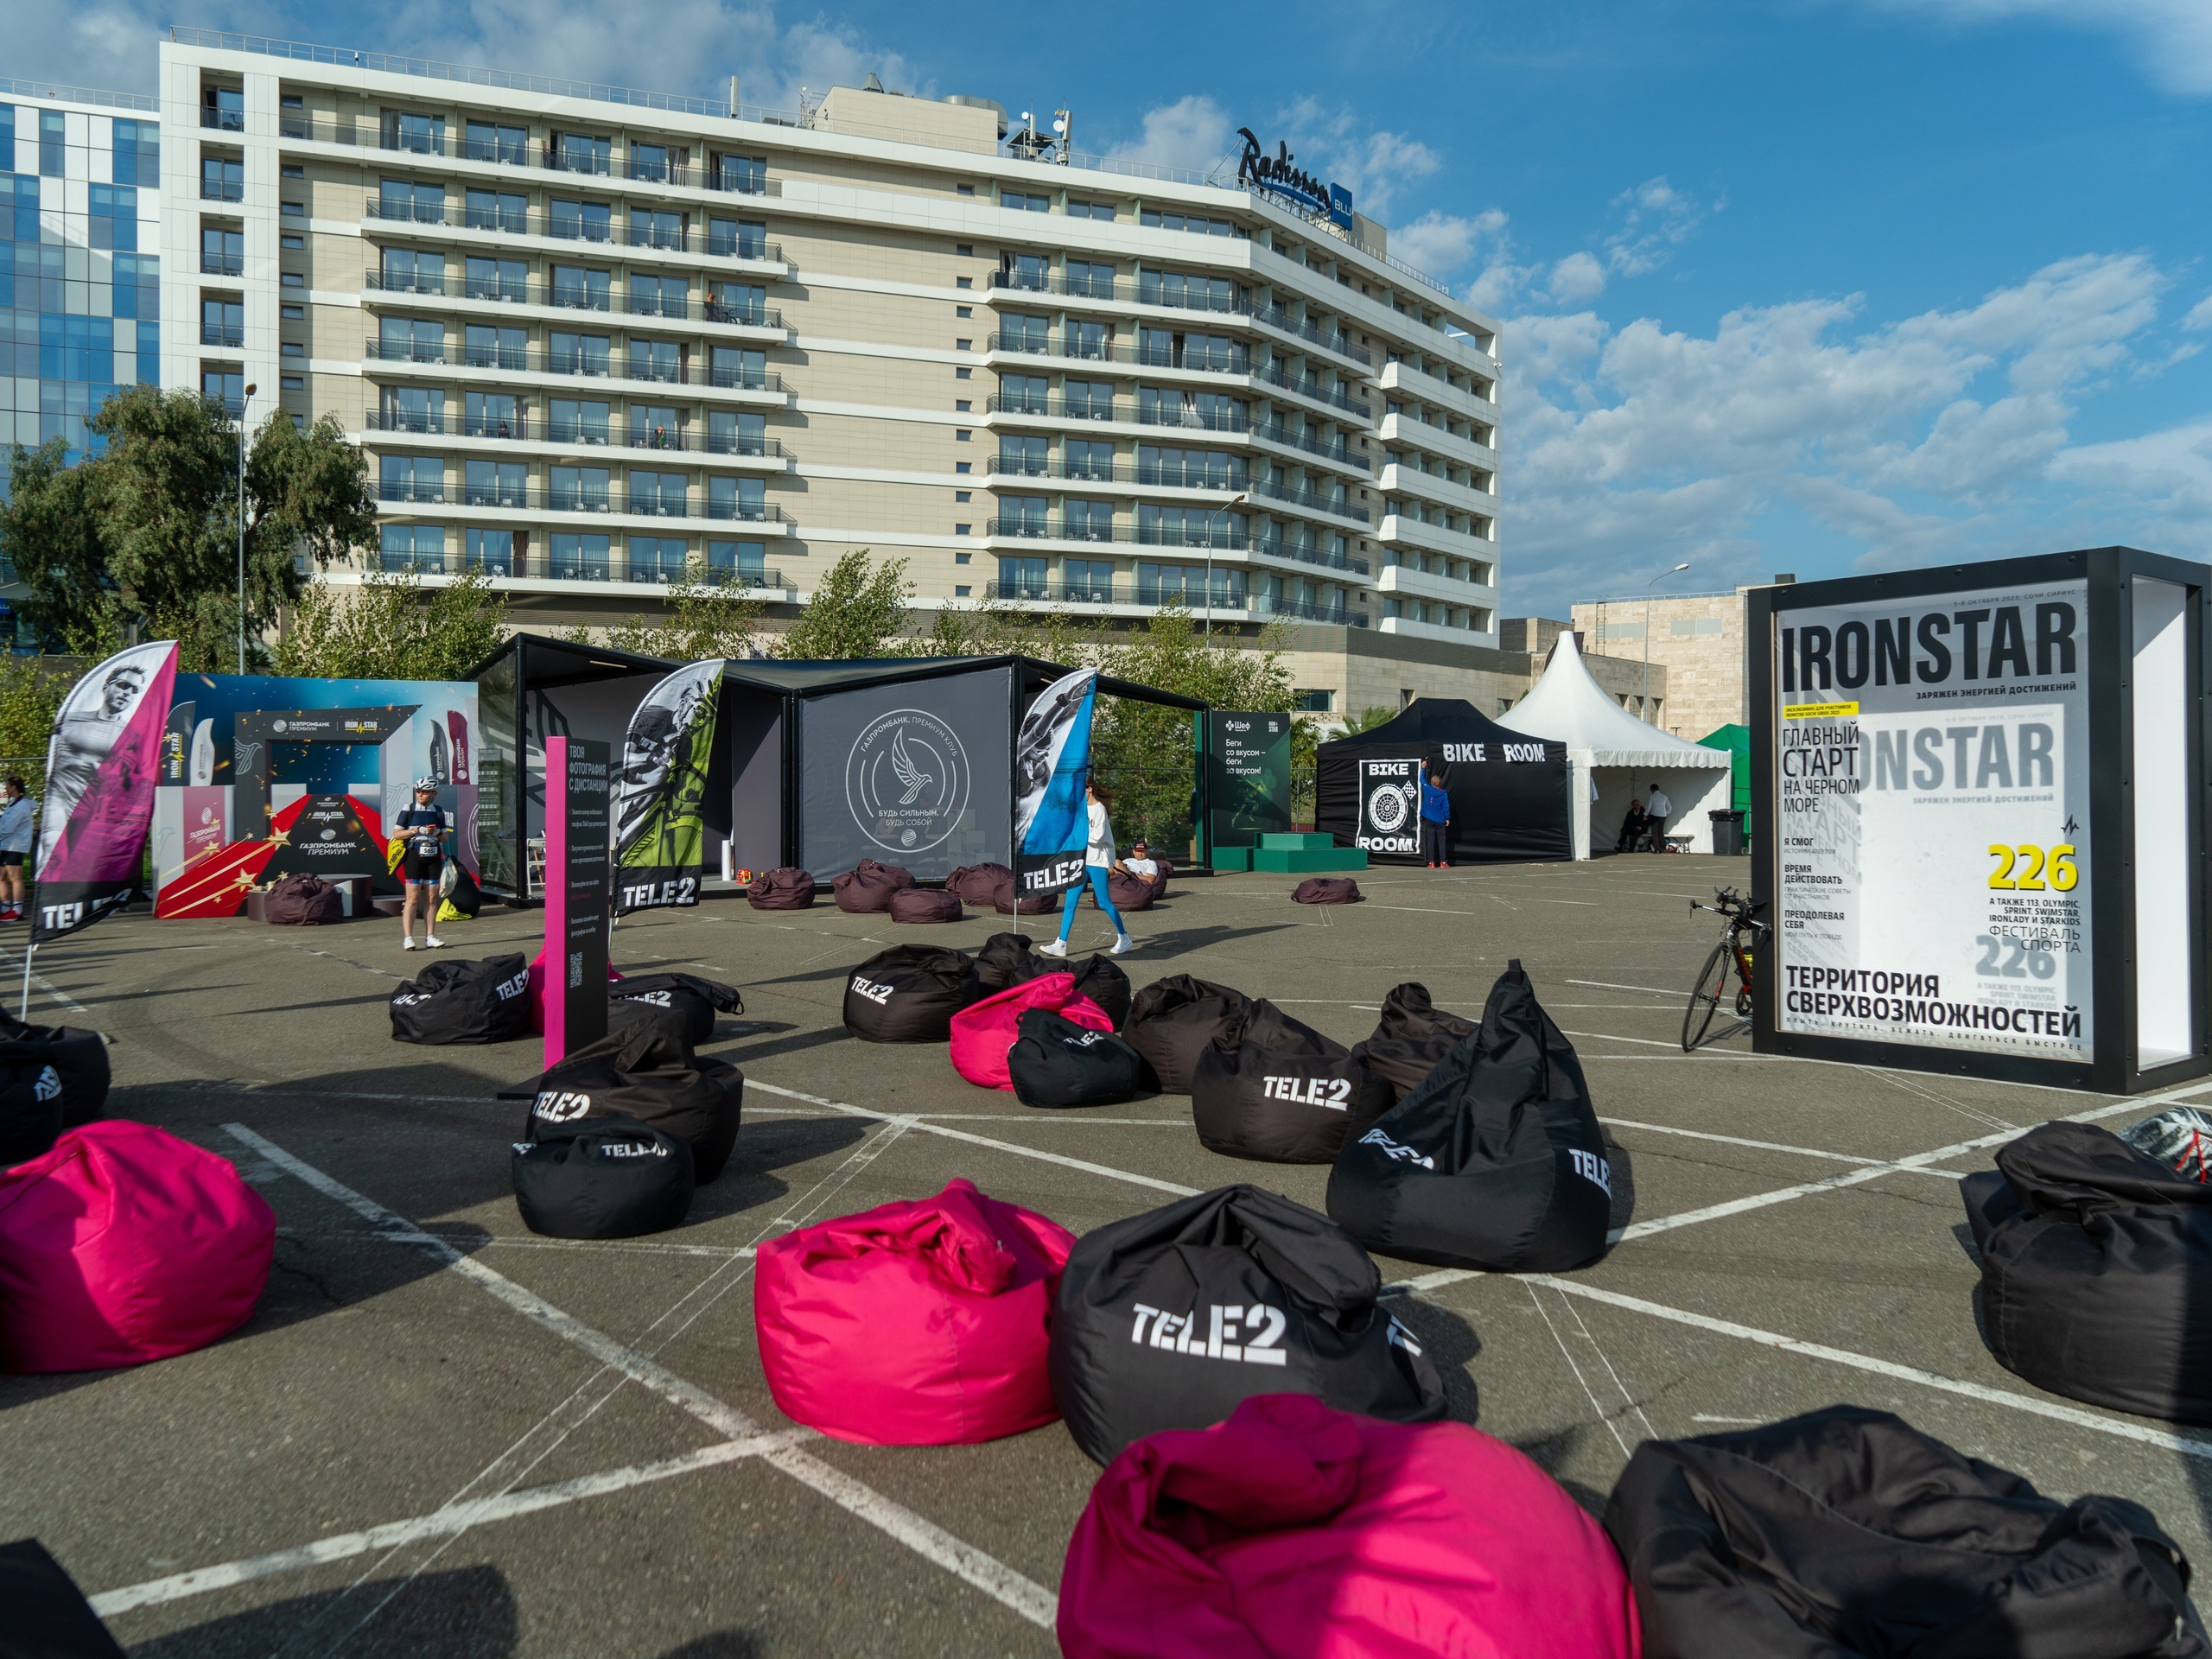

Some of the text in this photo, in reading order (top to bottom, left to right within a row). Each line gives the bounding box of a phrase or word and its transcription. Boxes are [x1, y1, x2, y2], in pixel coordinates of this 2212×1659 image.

[1236, 126, 1352, 217] Radisson BLU
[1967, 596, 1999, 606] ОКТЯБРЯ
[2046, 588, 2076, 597] СИРИУС
[1783, 601, 2077, 693] IRONSTAR
[1916, 680, 2077, 700] ЗАРЯЖЕН ЭНЕРГИЕЙ ДОСТИЖЕНИЙ
[1235, 721, 1251, 731] Шеф
[861, 716, 958, 757] ГАЗПРОМБАНК. ПРЕМИУМ КЛУБ
[1783, 721, 1859, 747] ГЛАВНЫЙ
[569, 745, 585, 759] ТВОЯ
[1236, 749, 1260, 758] вкусом
[1442, 743, 1546, 762] BIKE ROOM
[569, 762, 607, 776] ФОТОГРАФИЯ
[1225, 757, 1242, 766] беги
[1783, 747, 1859, 778] СТАРТ
[1236, 766, 1262, 776] вкусом!
[1369, 763, 1409, 776] BIKE
[569, 778, 608, 793] С ДИСТАНЦИИ
[1783, 779, 1859, 795] НА ЧЕРНОМ
[1783, 798, 1819, 812] МОРЕ
[1951, 794, 1992, 804] ЭНЕРГИЕЙ
[1993, 792, 2054, 804] ДОСТИЖЕНИЙ
[906, 817, 932, 826] СОБОЙ
[1358, 837, 1414, 852] ROOM
[1784, 837, 1815, 846] Я СМОГ
[1023, 858, 1084, 889] TELE2
[1784, 864, 1812, 873] ВРЕМЯ
[1987, 843, 2078, 892] 226
[1784, 873, 1843, 885] ДЕЙСТВОВАТЬ
[623, 877, 696, 906] TELE2
[1997, 898, 2024, 906] ТАКЖЕ
[1784, 909, 1845, 920] ПРЕОДОЛЕВАЯ
[1989, 914, 2029, 924] IRONLADY
[2040, 917, 2081, 926] STARKIDS
[1784, 920, 1804, 929] СЕБЯ
[1989, 925, 2081, 940] ФЕСТИВАЛЬ
[2020, 938, 2082, 953] СПОРТА
[496, 969, 530, 1001] TELE2
[1786, 965, 1940, 998] ТЕРРИТОРИЯ
[851, 976, 894, 1006] TELE2
[1786, 991, 2082, 1038] СВЕРХВОЗМОЖНОСТЕЙ
[1948, 1032, 2017, 1044] ДВИГАТЬСЯ
[2025, 1039, 2082, 1051] БЫСТРЕЕ
[1263, 1076, 1351, 1111] TELE2
[532, 1091, 590, 1122] TELE2
[1568, 1148, 1612, 1200] TELE
[1131, 1302, 1287, 1366] TELE2
